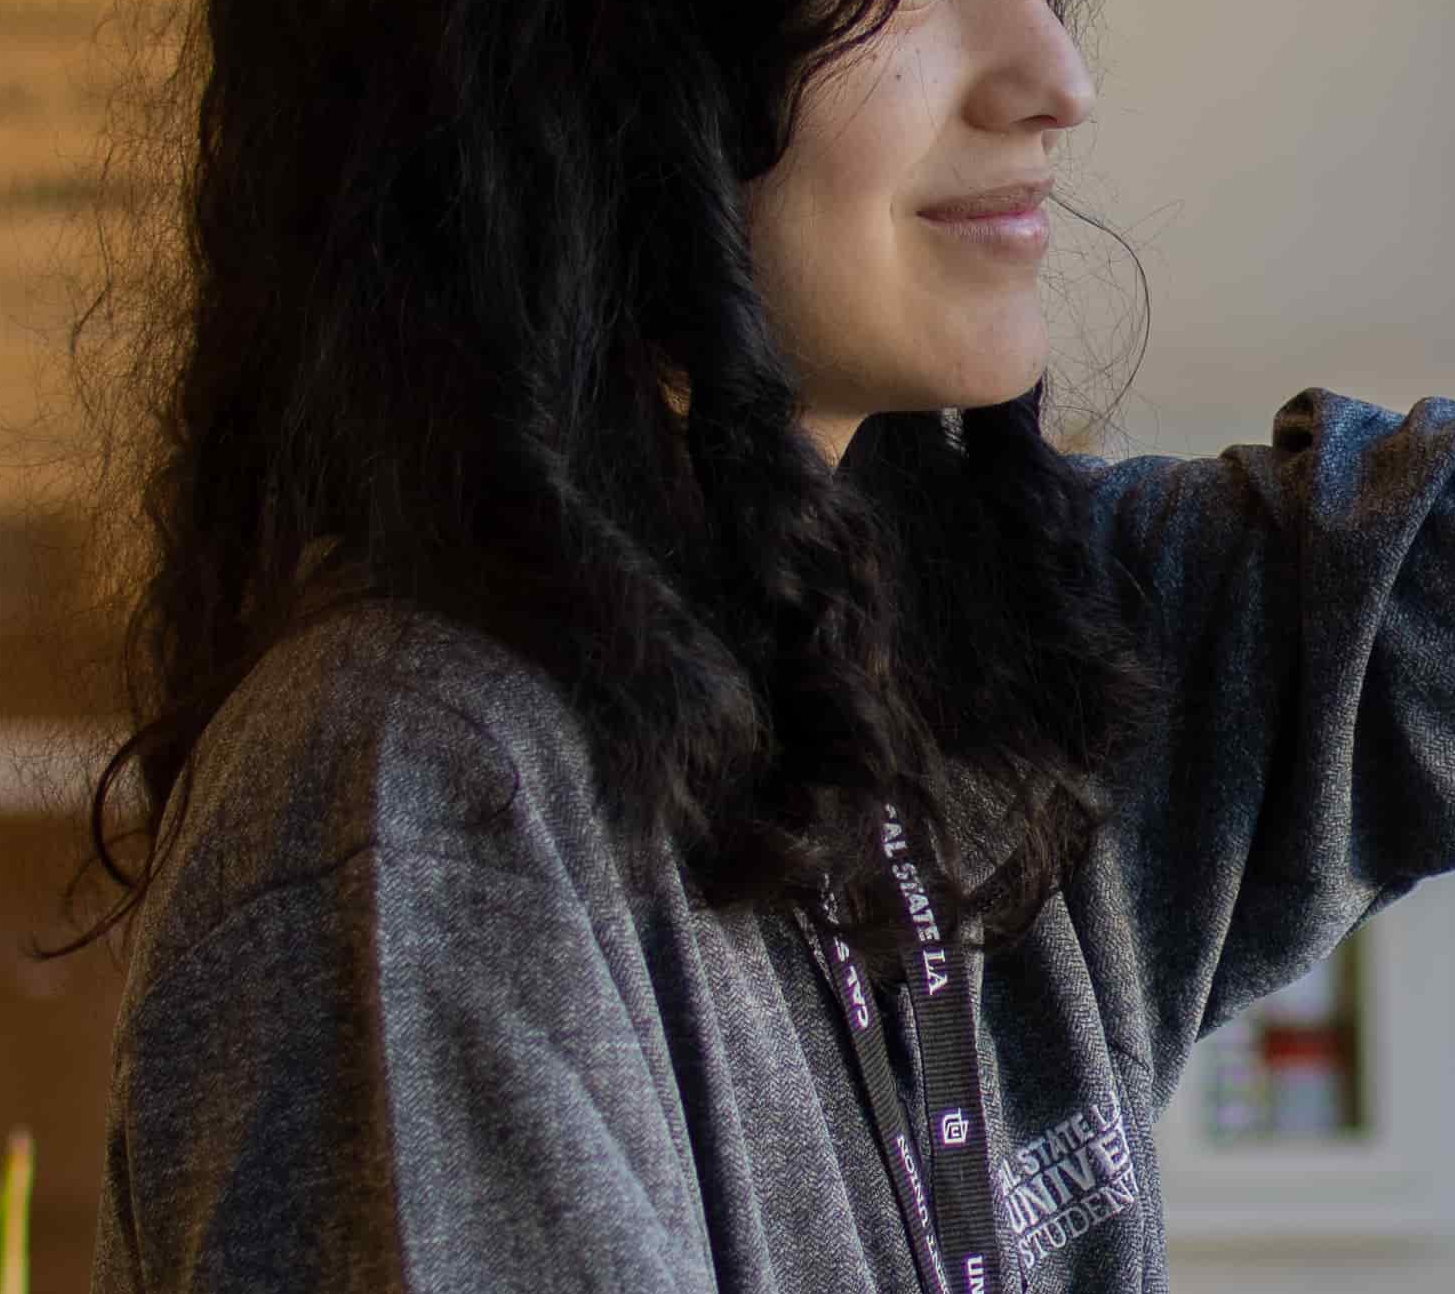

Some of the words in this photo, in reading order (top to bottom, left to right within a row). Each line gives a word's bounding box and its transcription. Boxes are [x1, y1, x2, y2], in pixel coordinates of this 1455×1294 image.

[892, 862, 941, 943] STATE
[923, 948, 948, 996] LA
[1017, 1111, 1096, 1175] STATE
[1017, 1162, 1140, 1270] STUDEN
